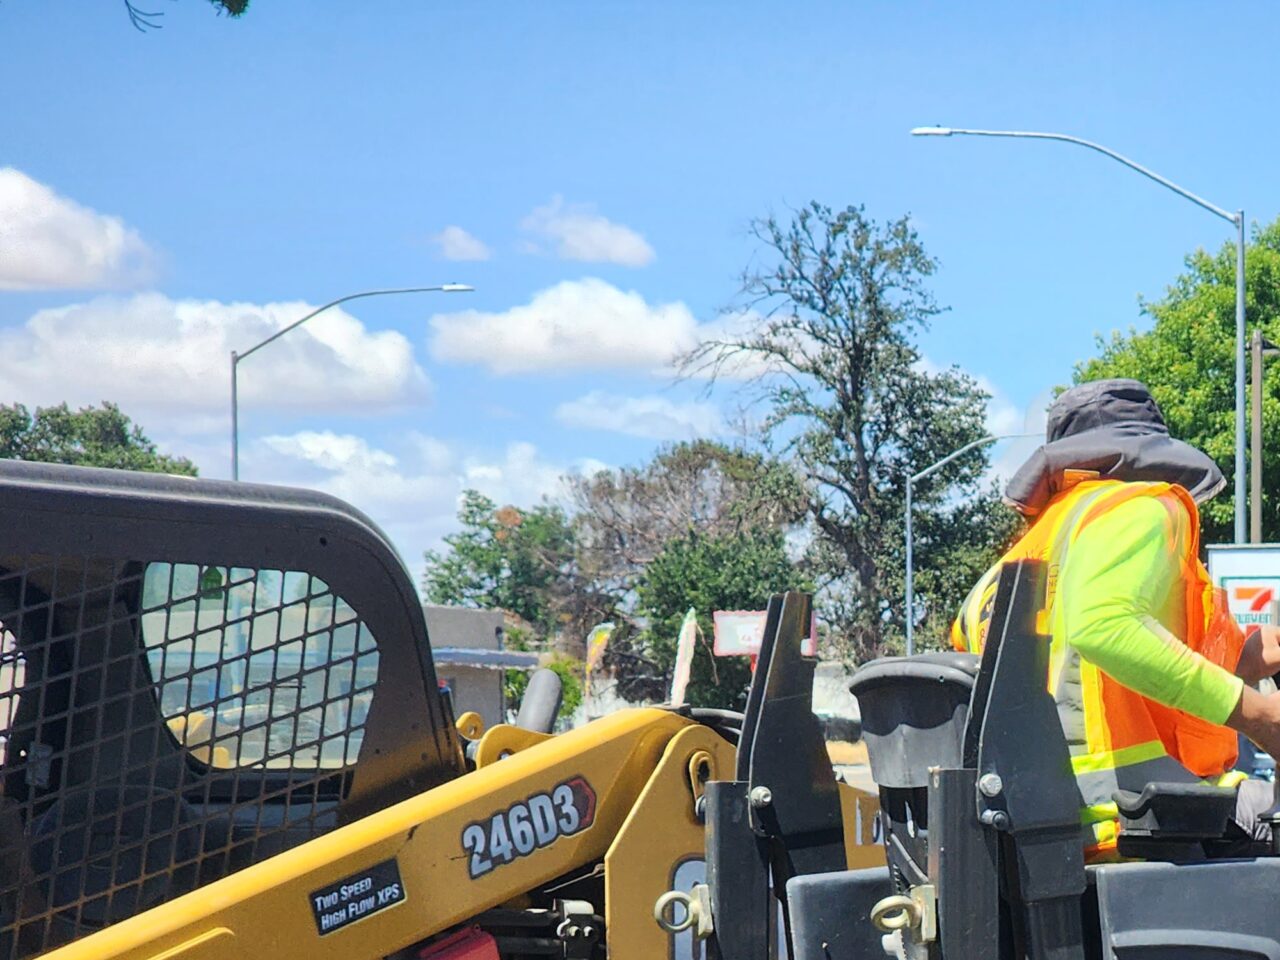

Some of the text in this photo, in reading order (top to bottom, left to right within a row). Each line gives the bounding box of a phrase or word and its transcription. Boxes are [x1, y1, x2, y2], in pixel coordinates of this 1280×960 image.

[463, 784, 579, 878] 246D3
[321, 883, 400, 930] HIGH FLOW XPS
